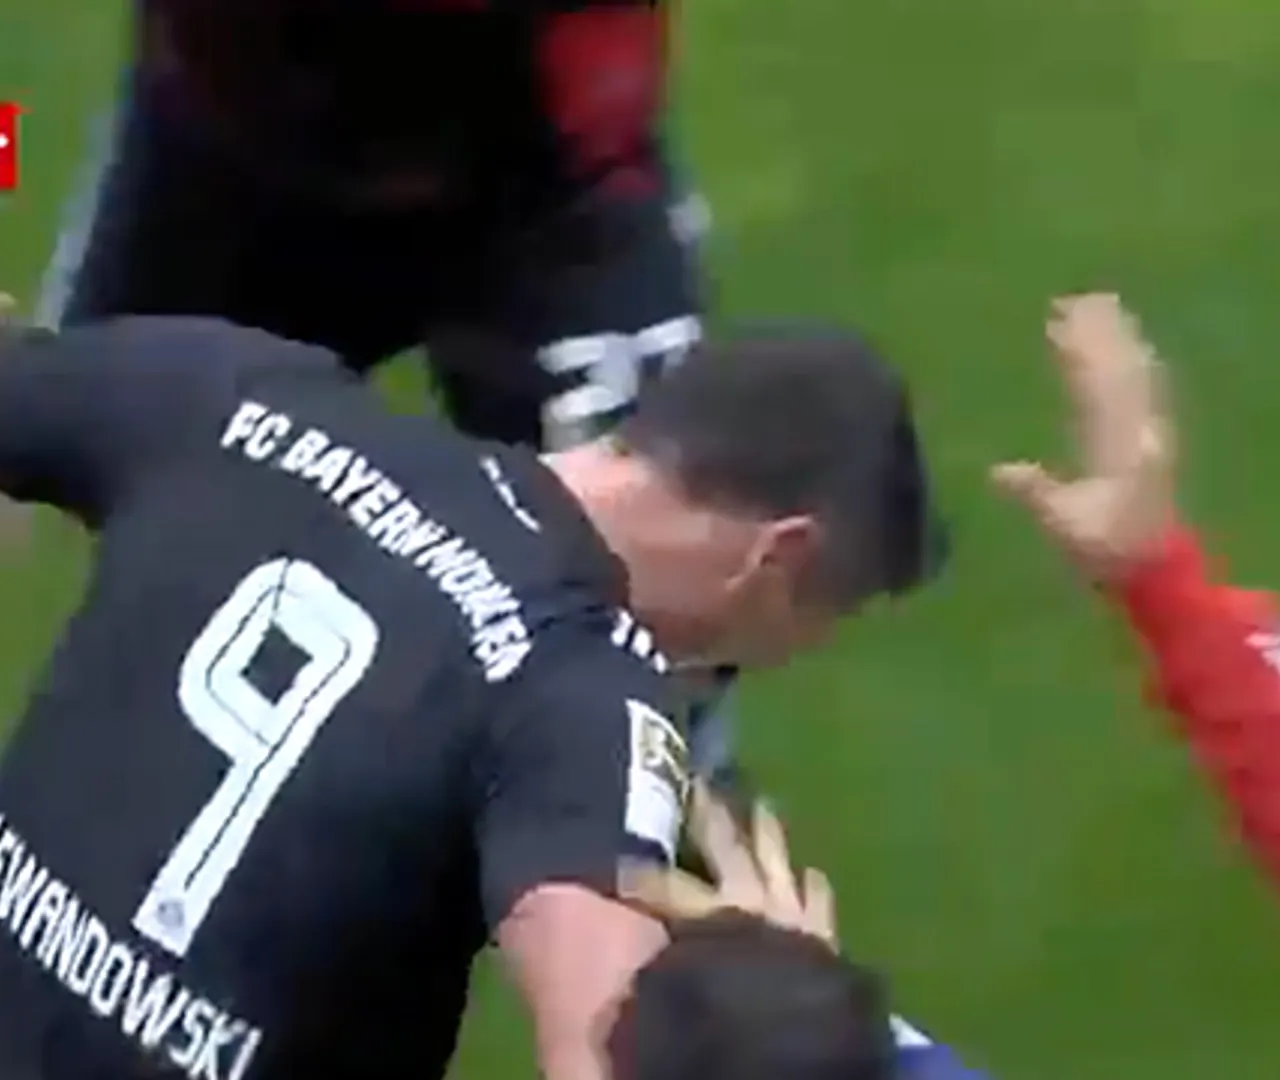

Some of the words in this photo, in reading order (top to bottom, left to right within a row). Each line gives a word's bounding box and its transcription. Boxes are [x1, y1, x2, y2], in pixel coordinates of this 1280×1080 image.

[220, 401, 292, 461] FC
[279, 428, 447, 556] BAYERN
[131, 556, 380, 957] 9
